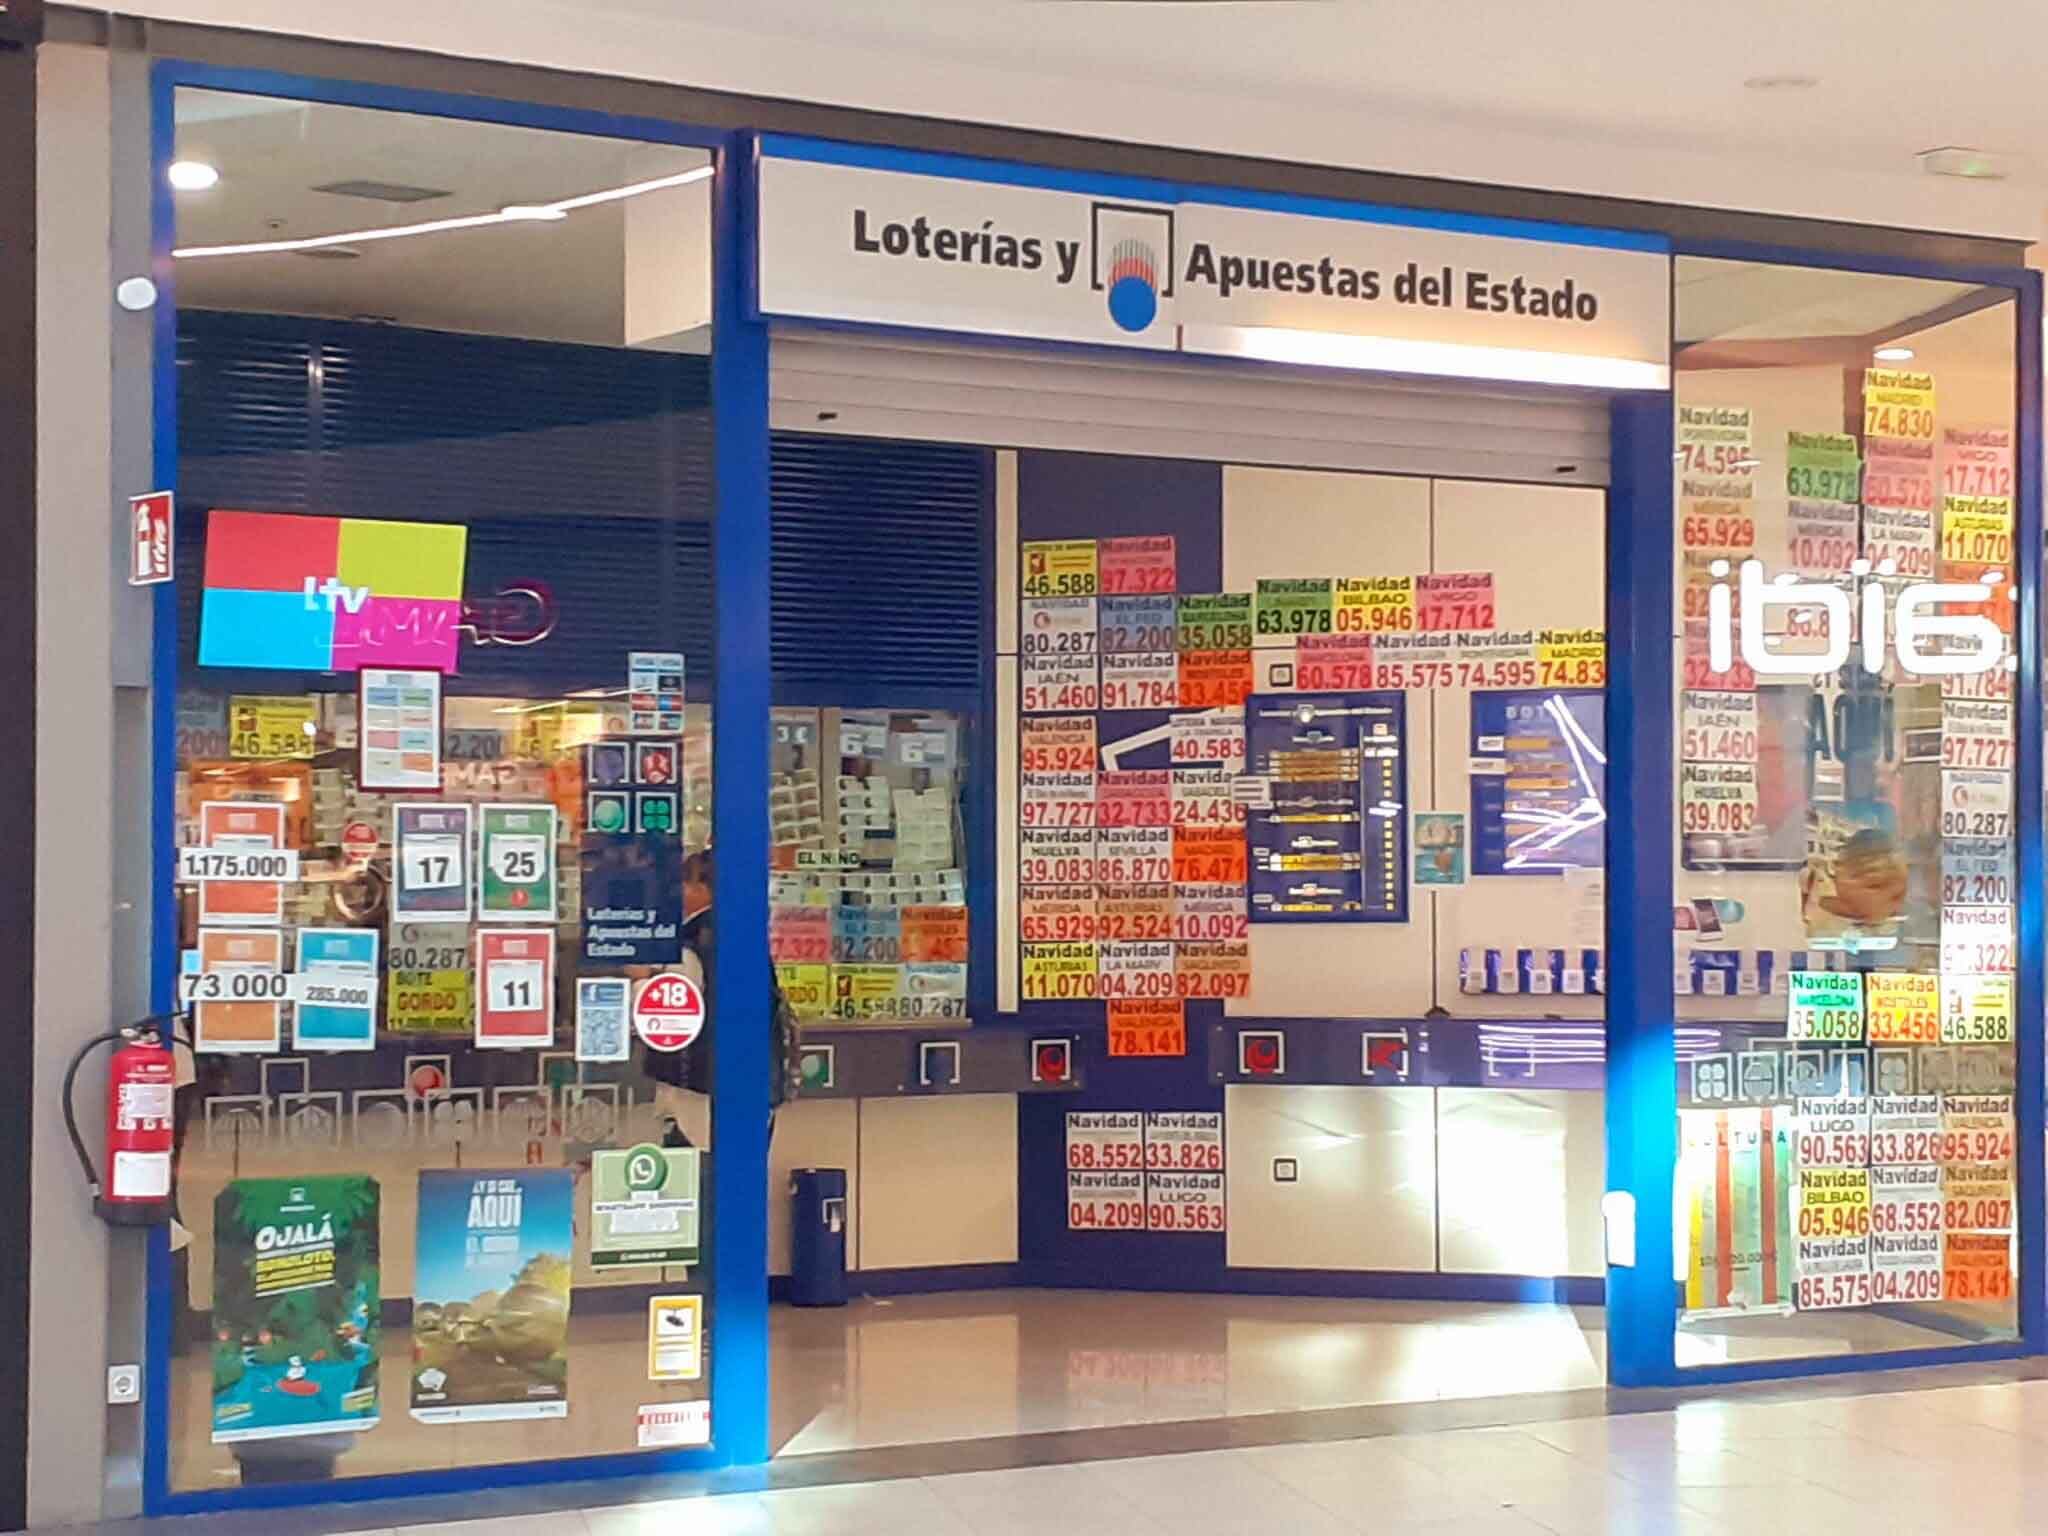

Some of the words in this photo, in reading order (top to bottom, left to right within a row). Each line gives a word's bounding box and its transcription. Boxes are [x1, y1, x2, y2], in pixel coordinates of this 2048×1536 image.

[852, 209, 1042, 270] Loterías
[1056, 236, 1079, 283] y
[1185, 242, 1380, 302] Apuestas
[1394, 261, 1452, 308] del
[1465, 271, 1599, 322] Estado
[1868, 372, 1932, 390] Navidad
[1679, 408, 1749, 426] Navidad
[1868, 407, 1933, 437] 74.830
[1683, 480, 1751, 497] Navidad
[1945, 466, 2009, 495] 17.712
[1944, 498, 2007, 514] Navidad
[1866, 507, 1929, 528] Navidad
[1684, 518, 1754, 546] 65.929
[1102, 537, 1171, 551] Navidad
[1789, 539, 1857, 569] 10.092
[1944, 531, 2009, 559] 11.070
[1024, 574, 1095, 595] 46.588
[1257, 579, 1330, 592] Navidad
[1337, 578, 1410, 591] Navidad
[1416, 573, 1491, 589] Navidad
[1102, 597, 1171, 610] Navidad
[1178, 595, 1250, 609] Navidad
[1343, 594, 1407, 605] BILBAO
[1257, 610, 1331, 633] 63.978
[1337, 608, 1412, 631] 05.946
[1418, 605, 1494, 630] 17.712
[1023, 632, 1096, 652] 80.287
[1103, 627, 1173, 651] 82.200
[1180, 625, 1252, 648] 35.058
[1297, 635, 1369, 647] Navidad
[1376, 634, 1450, 648] Navidad
[1456, 630, 1533, 646] Navidad
[1024, 656, 1094, 671] Navidad
[1103, 654, 1174, 668] Navidad
[1179, 652, 1250, 664] Navidad
[1297, 666, 1372, 688] 60.578
[1377, 664, 1453, 688] 85.575
[1457, 660, 1535, 686] 74.595
[1024, 686, 1096, 709] 51.460
[1103, 682, 1176, 707] 91.784
[1685, 693, 1752, 710] Navidad
[1943, 704, 2007, 720] Navidad
[1023, 719, 1092, 732] Navidad
[1172, 739, 1245, 759] 40.583
[1685, 729, 1755, 758] 51.460
[1942, 739, 2010, 766] 97.727
[1023, 747, 1095, 771] 95.924
[1023, 773, 1093, 786] Navidad
[1098, 771, 1169, 785] Navidad
[1685, 765, 1752, 782] Navidad
[1023, 803, 1094, 826] 97.727
[1100, 802, 1171, 826] 32.733
[1174, 800, 1248, 823] 24.436
[1685, 802, 1754, 831] 39.083
[1943, 812, 2008, 835] 80.287
[1022, 830, 1093, 844] Navidad
[1098, 829, 1169, 843] Navidad
[1175, 828, 1245, 841] Navidad
[1031, 847, 1080, 856] HUELVA
[418, 857, 449, 882] 17
[504, 852, 535, 877] 25
[1023, 858, 1094, 882] 39.083
[1101, 858, 1170, 881] 86.870
[1175, 857, 1245, 881] 76.471
[1023, 886, 1093, 900] Navidad
[1100, 885, 1169, 899] Navidad
[1174, 885, 1245, 898] Navidad
[1944, 876, 2007, 903] 82.200
[1023, 916, 1095, 939] 65.929
[1101, 915, 1172, 939] 92.524
[1176, 914, 1248, 938] 10.092
[1944, 910, 2006, 924] Navidad
[389, 948, 465, 968] 80.287
[1024, 944, 1093, 958] Navidad
[1100, 943, 1170, 957] Navidad
[1176, 943, 1247, 957] Navidad
[504, 981, 530, 1006] 11
[1024, 974, 1096, 997] 11.070
[1101, 973, 1173, 996] 04.209
[1176, 973, 1249, 996] 82.097
[1792, 976, 1858, 990] Navidad
[1870, 977, 1935, 991] Navidad
[399, 992, 456, 1010] GORDO
[648, 982, 688, 1006] +18
[1111, 1001, 1181, 1014] Navidad
[1793, 1011, 1859, 1038] 35.058
[1870, 1012, 1936, 1039] 33.456
[1944, 1016, 2007, 1040] 46.588
[1112, 1030, 1181, 1053] 78.141
[1801, 1099, 1867, 1115] Navidad
[1873, 1099, 1937, 1114] Navidad
[1944, 1098, 2009, 1113] Navidad
[1069, 1114, 1139, 1128] Navidad
[1148, 1113, 1218, 1128] Navidad
[1070, 1143, 1141, 1167] 68.552
[1147, 1143, 1220, 1168] 33.826
[1801, 1135, 1867, 1164] 90.563
[1873, 1133, 1939, 1162] 33.826
[1944, 1133, 2011, 1160] 95.924
[1071, 1174, 1140, 1187] Navidad
[1150, 1175, 1220, 1189] Navidad
[1801, 1171, 1866, 1188] Navidad
[1873, 1167, 1937, 1184] Navidad
[1946, 1166, 2008, 1181] Navidad
[1807, 1191, 1864, 1204] BILBAO
[1071, 1202, 1142, 1226] 04.209
[1149, 1205, 1222, 1229] 90.563
[1800, 1207, 1869, 1236] 05.946
[1872, 1203, 1940, 1232] 68.552
[1945, 1201, 2011, 1228] 82.097
[255, 1213, 334, 1250] OJALÁ
[1801, 1240, 1866, 1258] Navidad
[1874, 1234, 1937, 1251] Navidad
[1947, 1235, 2009, 1250] Navidad
[1801, 1275, 1869, 1306] 85.575
[1873, 1271, 1940, 1299] 04.209
[1948, 1271, 2010, 1297] 78.141
